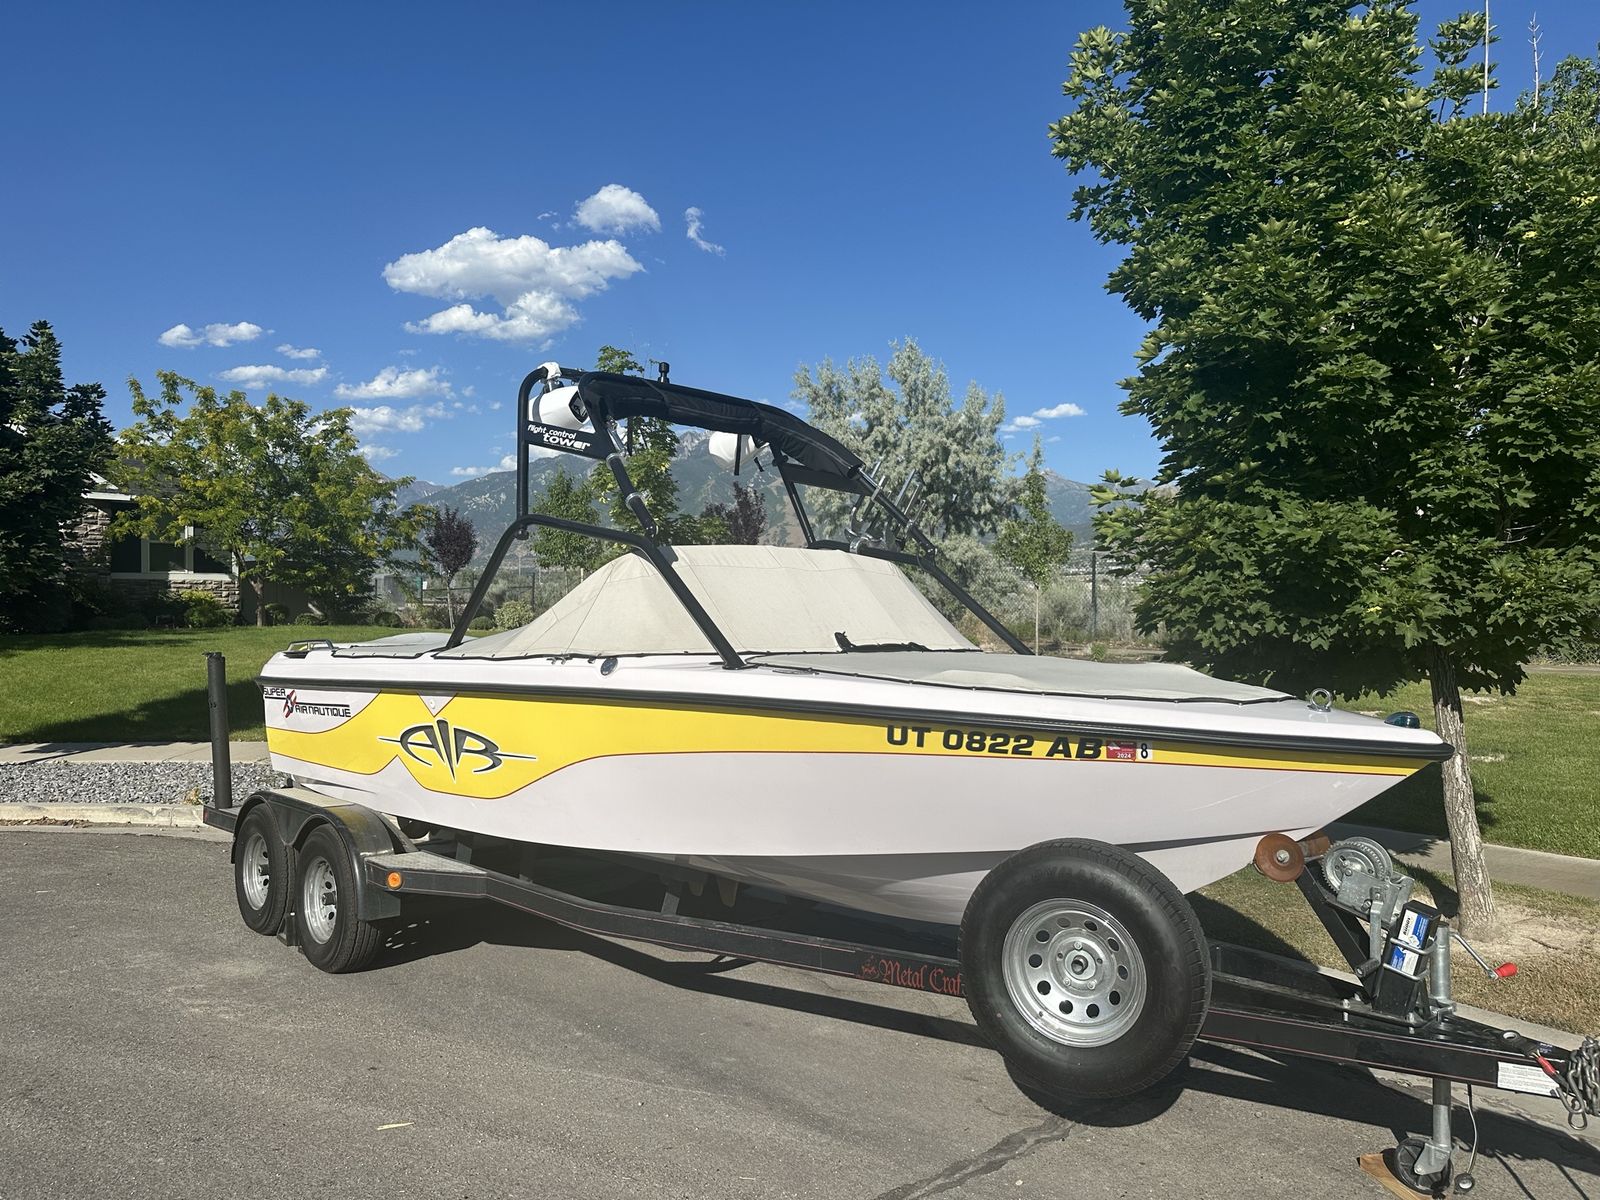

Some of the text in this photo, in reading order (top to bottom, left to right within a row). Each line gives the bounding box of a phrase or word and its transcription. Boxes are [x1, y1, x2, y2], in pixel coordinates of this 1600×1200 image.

[527, 424, 577, 440] flight control
[543, 432, 591, 450] tower
[263, 687, 286, 696] SUPER
[887, 724, 1104, 759] UT 0822 AB
[1140, 742, 1149, 759] 8
[879, 959, 928, 989] Metal
